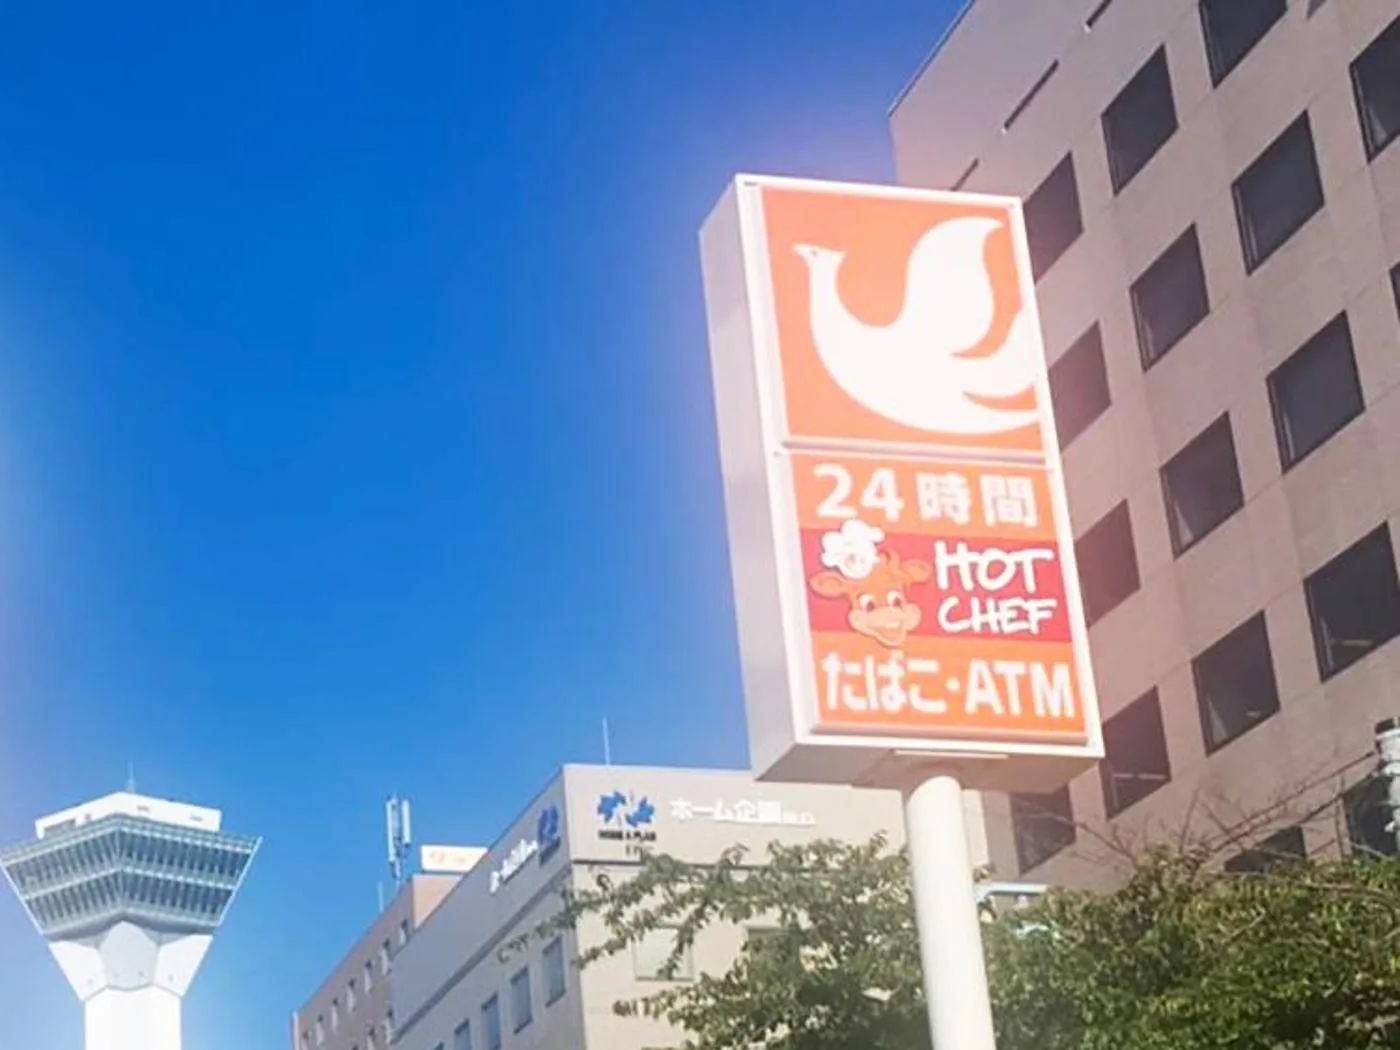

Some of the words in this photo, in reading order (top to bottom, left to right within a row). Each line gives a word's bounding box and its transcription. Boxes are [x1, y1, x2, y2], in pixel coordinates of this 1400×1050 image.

[812, 463, 1040, 529] 24時間
[934, 540, 1055, 593] HOT
[937, 596, 1058, 635] CHEF
